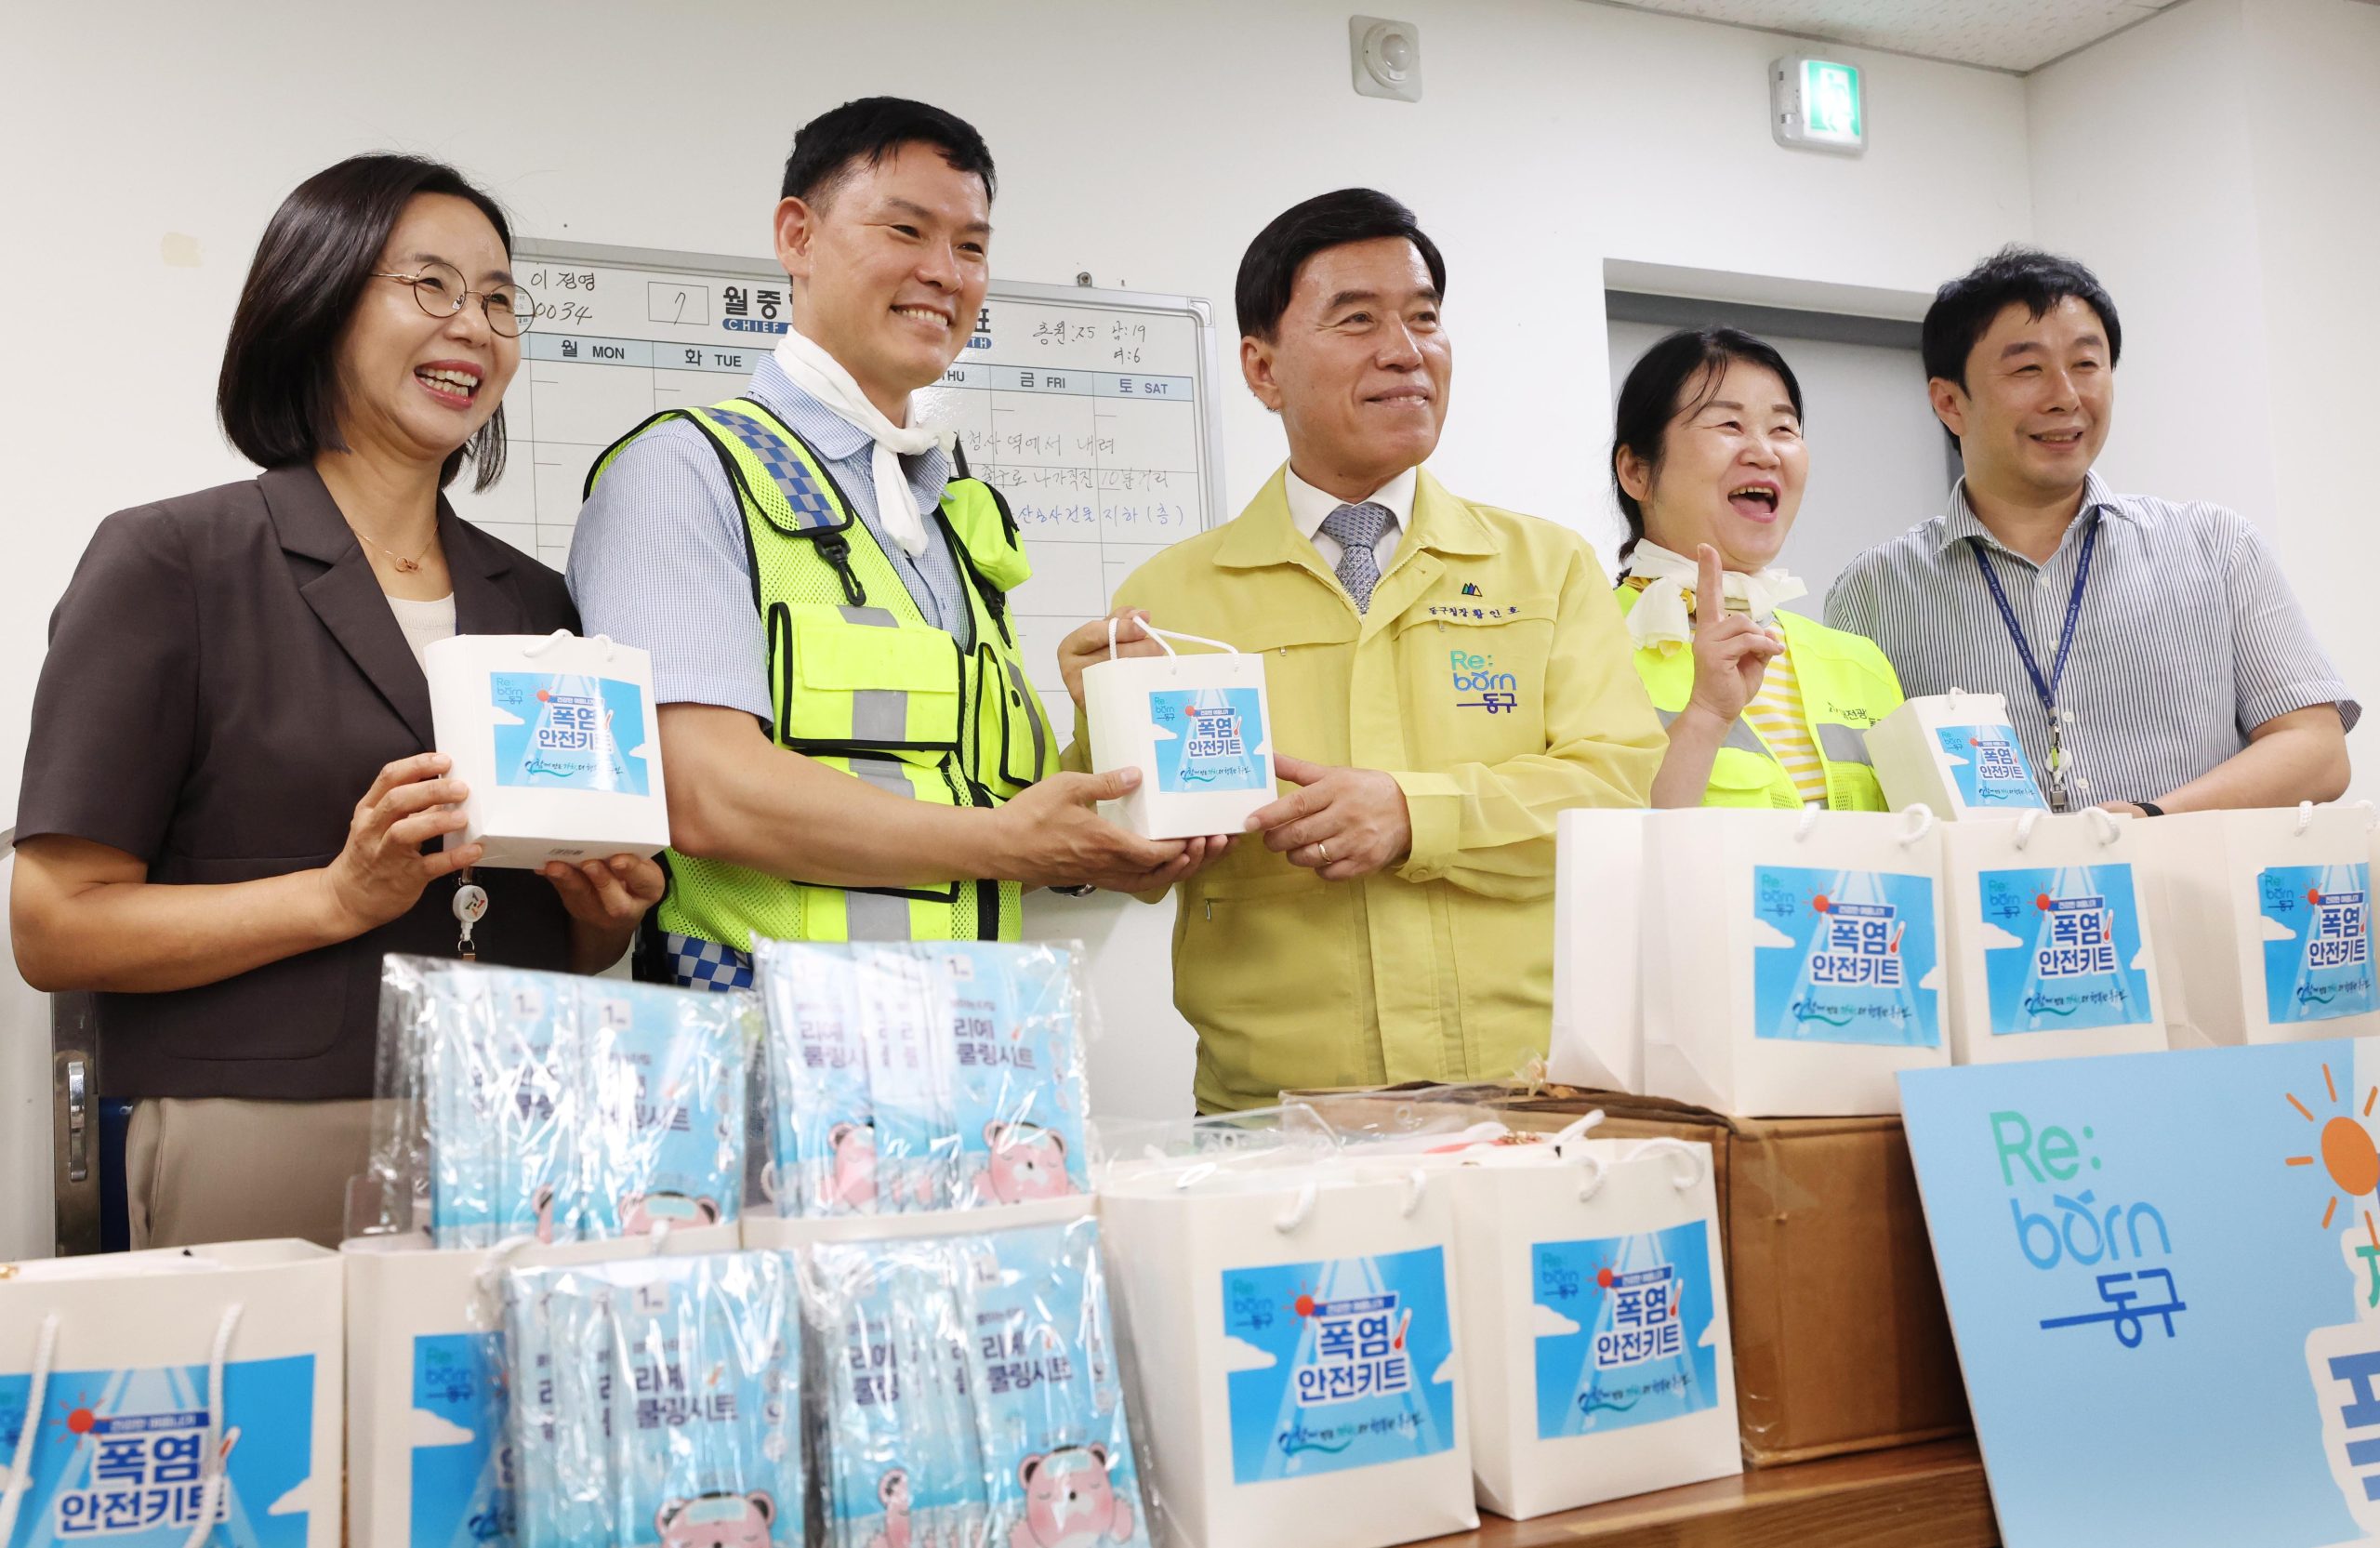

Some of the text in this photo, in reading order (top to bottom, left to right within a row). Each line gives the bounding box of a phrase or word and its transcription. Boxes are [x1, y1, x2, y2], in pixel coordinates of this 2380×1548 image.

[531, 269, 547, 289] 이
[723, 286, 792, 319] 월중
[728, 320, 779, 333] CHIEF
[562, 340, 625, 360] 월 MON
[685, 350, 742, 367] 화 TUE
[1020, 372, 1065, 389] 금 FRI
[1119, 378, 1169, 394] 토 SAT
[1450, 650, 1493, 670] Re:
[1457, 693, 1517, 714] 동구
[539, 730, 600, 750] 안전키
[1197, 718, 1233, 739] 폭염
[1189, 739, 1241, 757] 안전키트
[1983, 748, 2014, 764] 폭염
[1979, 766, 2024, 778] 안전키트
[2055, 912, 2101, 946] 폭염
[2321, 906, 2360, 938] 폭염
[1832, 919, 1887, 955] 폭염
[2039, 946, 2114, 976] 안전키트
[2309, 939, 2365, 967] 안전키트
[1813, 956, 1899, 985] 안전키트
[1990, 1110, 2101, 1186] Re:
[2010, 1189, 2172, 1270] born
[1616, 1285, 1667, 1328] 폭염
[2040, 1267, 2187, 1349] 동구
[1321, 1316, 1389, 1360] 폭염
[1597, 1324, 1680, 1366] 안전키트
[1299, 1357, 1408, 1402] 안전키트
[98, 1434, 201, 1486] 폭염
